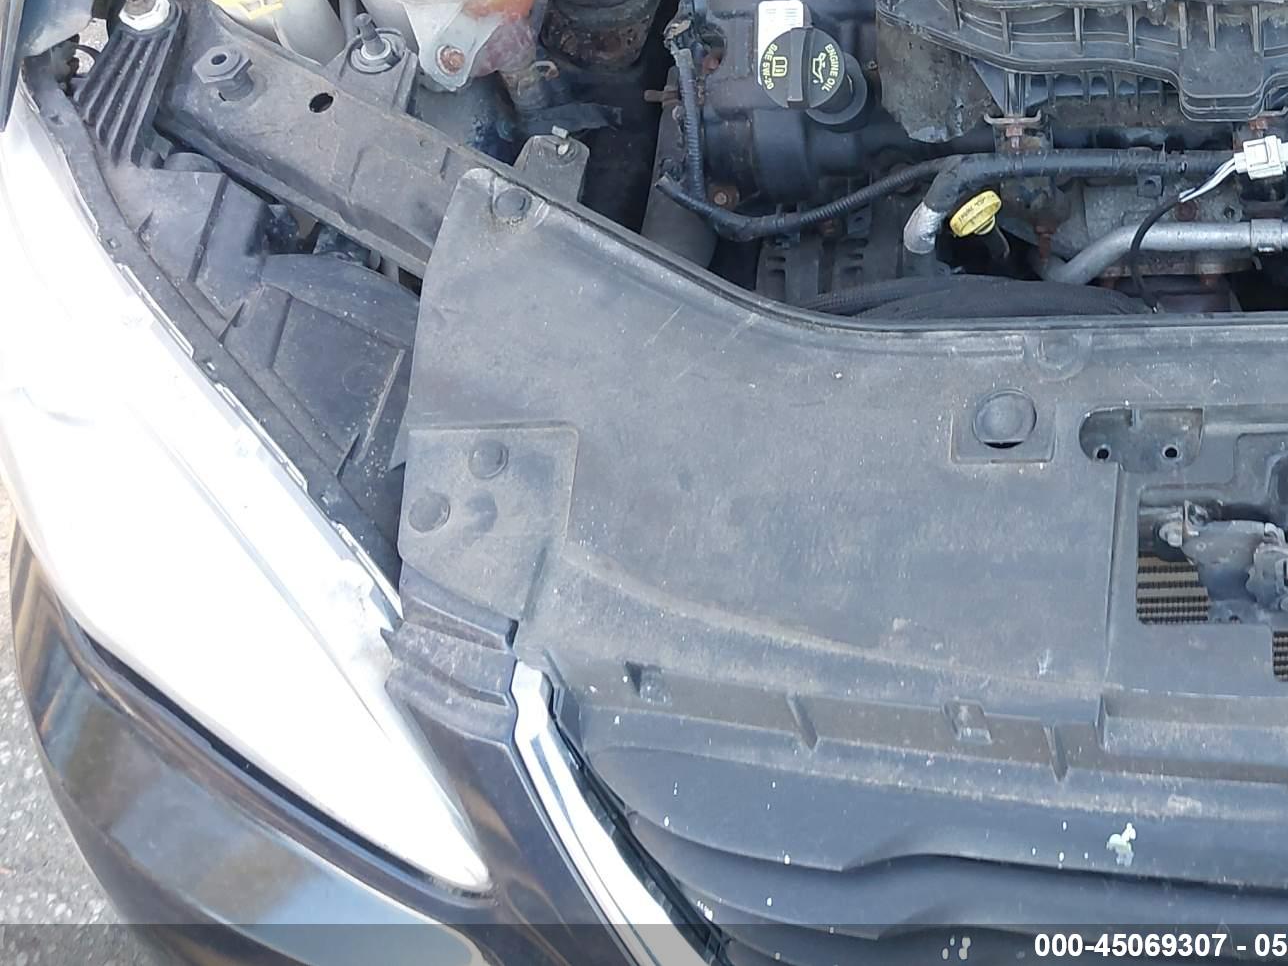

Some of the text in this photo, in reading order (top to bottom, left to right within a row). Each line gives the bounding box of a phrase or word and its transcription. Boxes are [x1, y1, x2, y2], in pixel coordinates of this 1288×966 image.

[762, 61, 775, 90] 5W-20
[821, 43, 840, 92] ENGINE OIL
